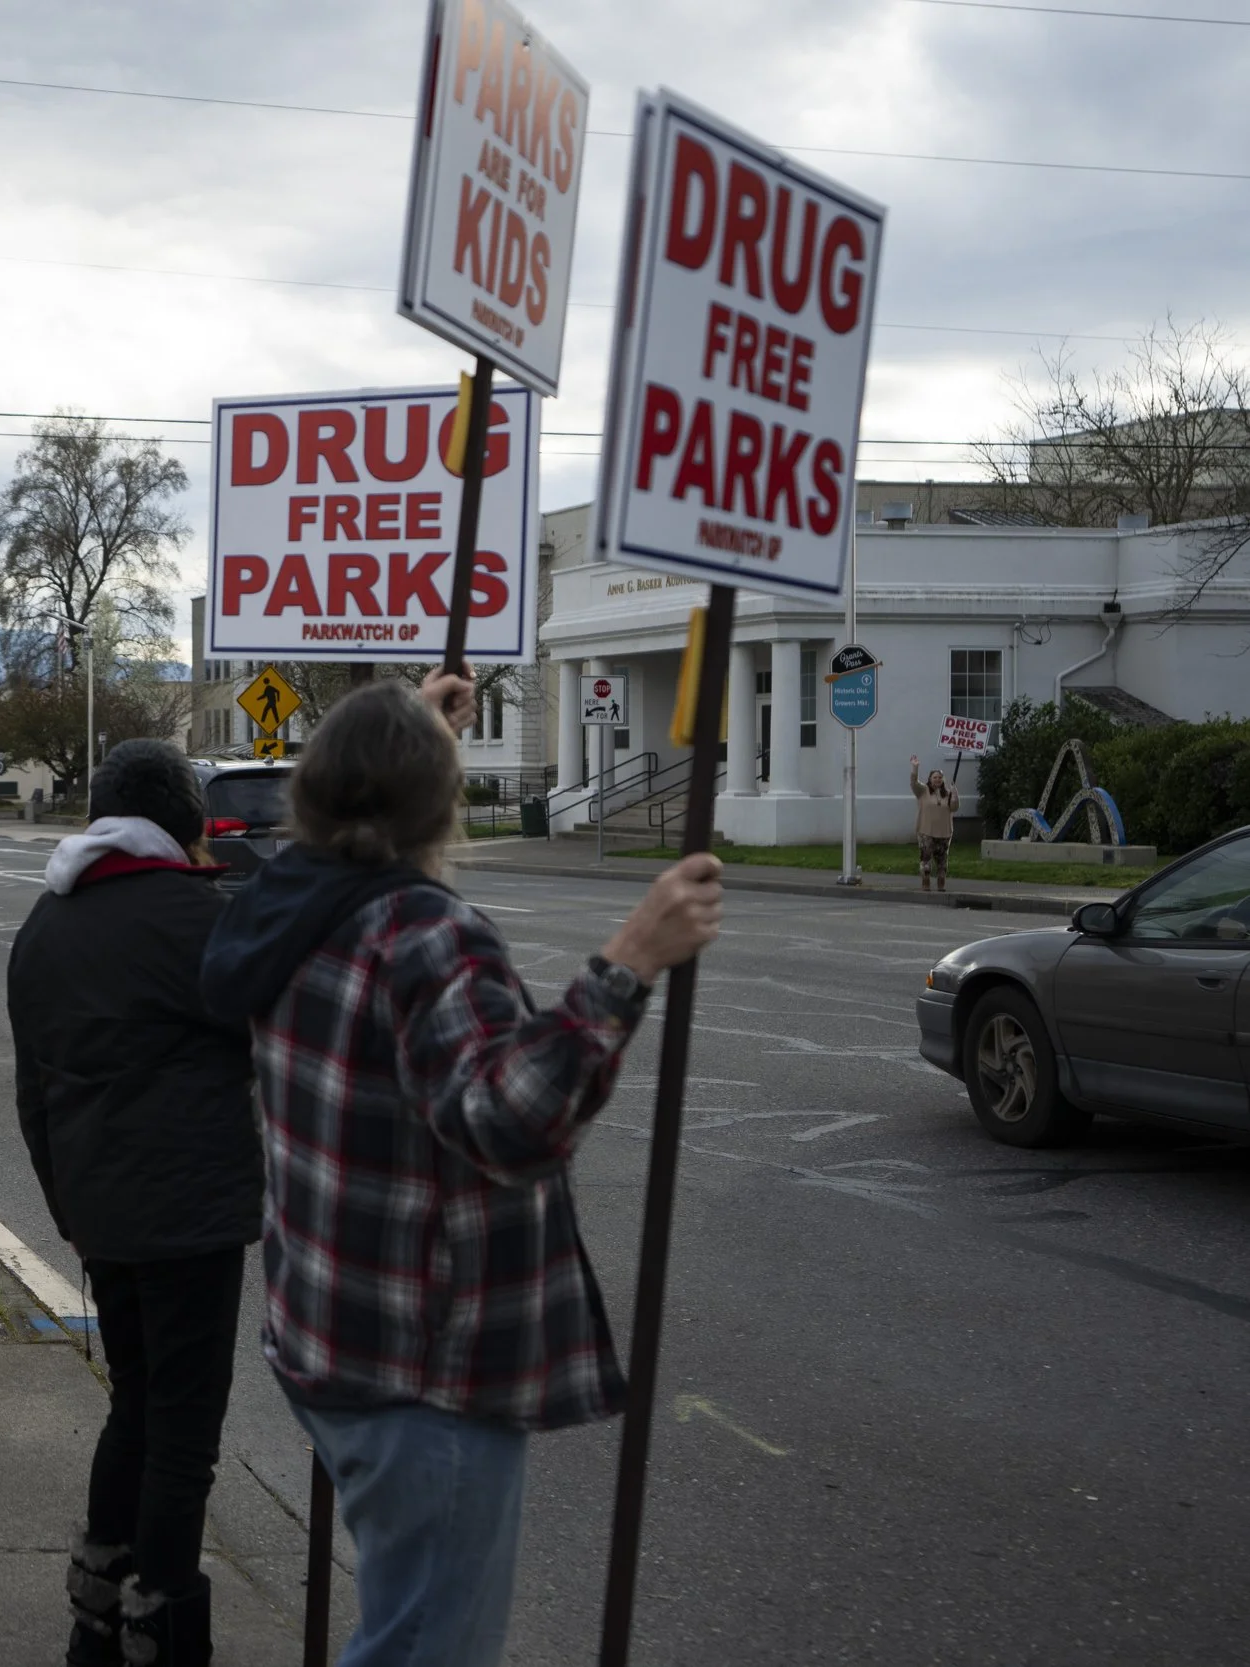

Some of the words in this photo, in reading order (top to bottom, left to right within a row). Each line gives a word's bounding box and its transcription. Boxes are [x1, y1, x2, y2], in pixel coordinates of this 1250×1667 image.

[453, 0, 577, 195] PARKS
[478, 139, 512, 194] ARE
[516, 168, 547, 222] FOR
[453, 173, 550, 327] KIDS
[665, 131, 867, 335] DRUG
[703, 300, 816, 413] FREE
[230, 400, 512, 487] DRUG
[635, 380, 844, 538] PARKS
[288, 491, 443, 542] FREE
[221, 550, 510, 619] PARKS
[301, 623, 395, 641] PARKWATCH
[398, 624, 420, 641] GP
[839, 650, 863, 663] Grants
[844, 659, 862, 669] Pass
[584, 698, 599, 706] HERE
[594, 684, 611, 694] STOP
[596, 712, 608, 720] FOR
[945, 717, 987, 733] DRUG
[941, 734, 984, 749] PARKS
[952, 729, 977, 739] FREE
